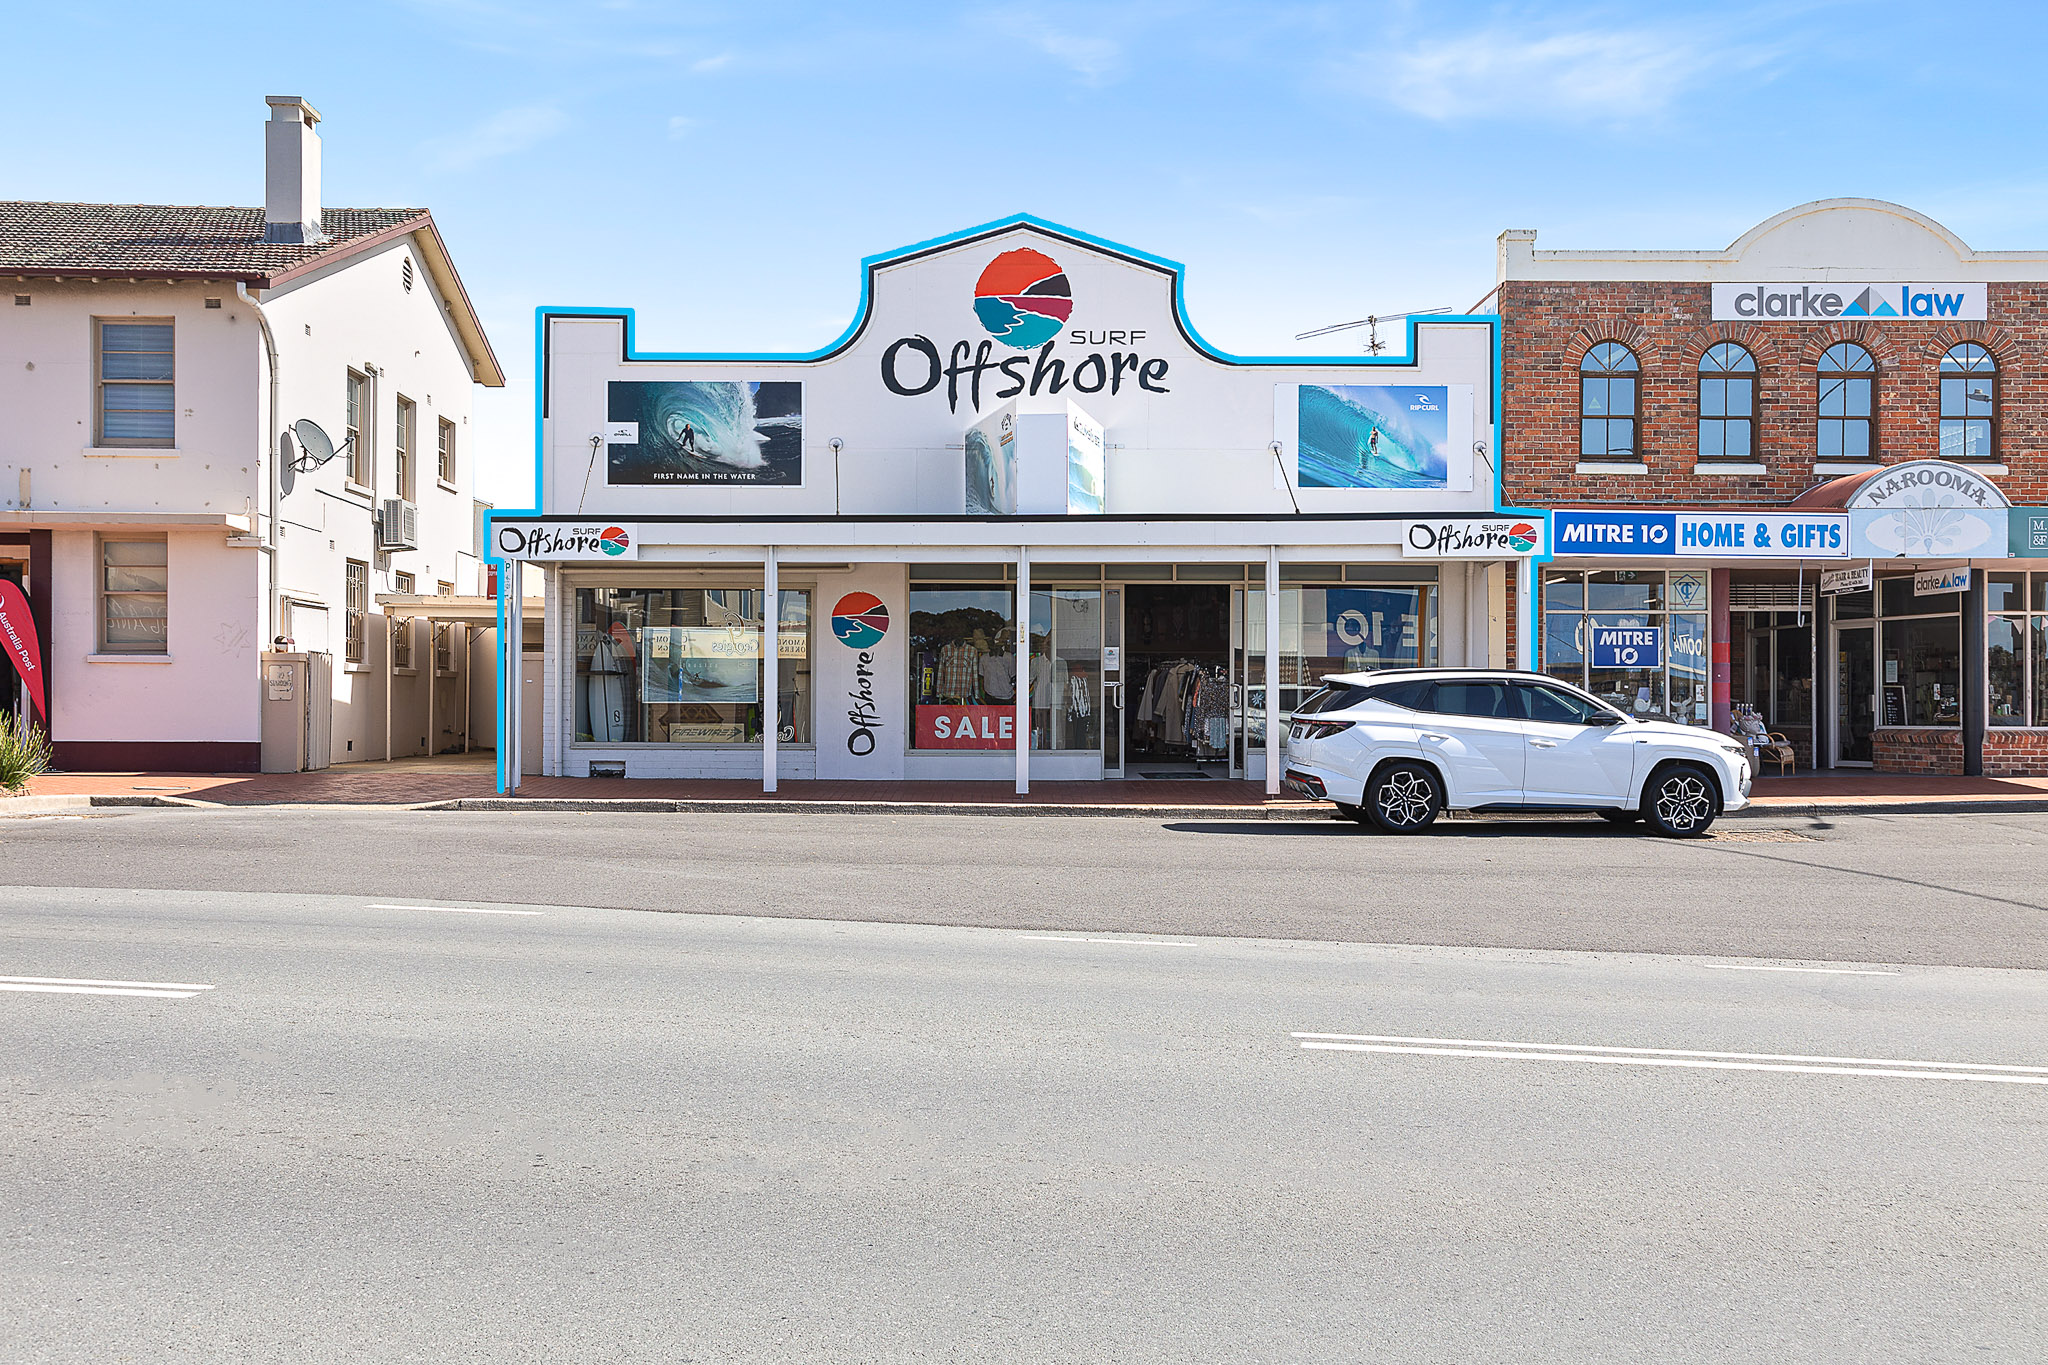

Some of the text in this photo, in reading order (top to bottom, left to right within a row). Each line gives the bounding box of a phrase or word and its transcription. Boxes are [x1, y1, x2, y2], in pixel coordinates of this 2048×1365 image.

[1734, 286, 1965, 317] clarke law
[1070, 330, 1147, 345] SURF
[881, 333, 1171, 415] Offshore
[1867, 469, 1987, 507] NAROOMA
[572, 527, 601, 535] SURF
[1409, 523, 1509, 555] Offshore
[1482, 524, 1510, 532] SURF
[1562, 522, 1841, 549] MITRE 10 HOME & GIFTS
[499, 526, 600, 559] Offshore
[1915, 572, 1968, 592] clarke law
[0, 611, 36, 672] Australia Post
[1599, 631, 1653, 646] MITRE
[1613, 647, 1639, 665] 10
[847, 651, 884, 757] Offshore
[934, 715, 1013, 739] SALE
